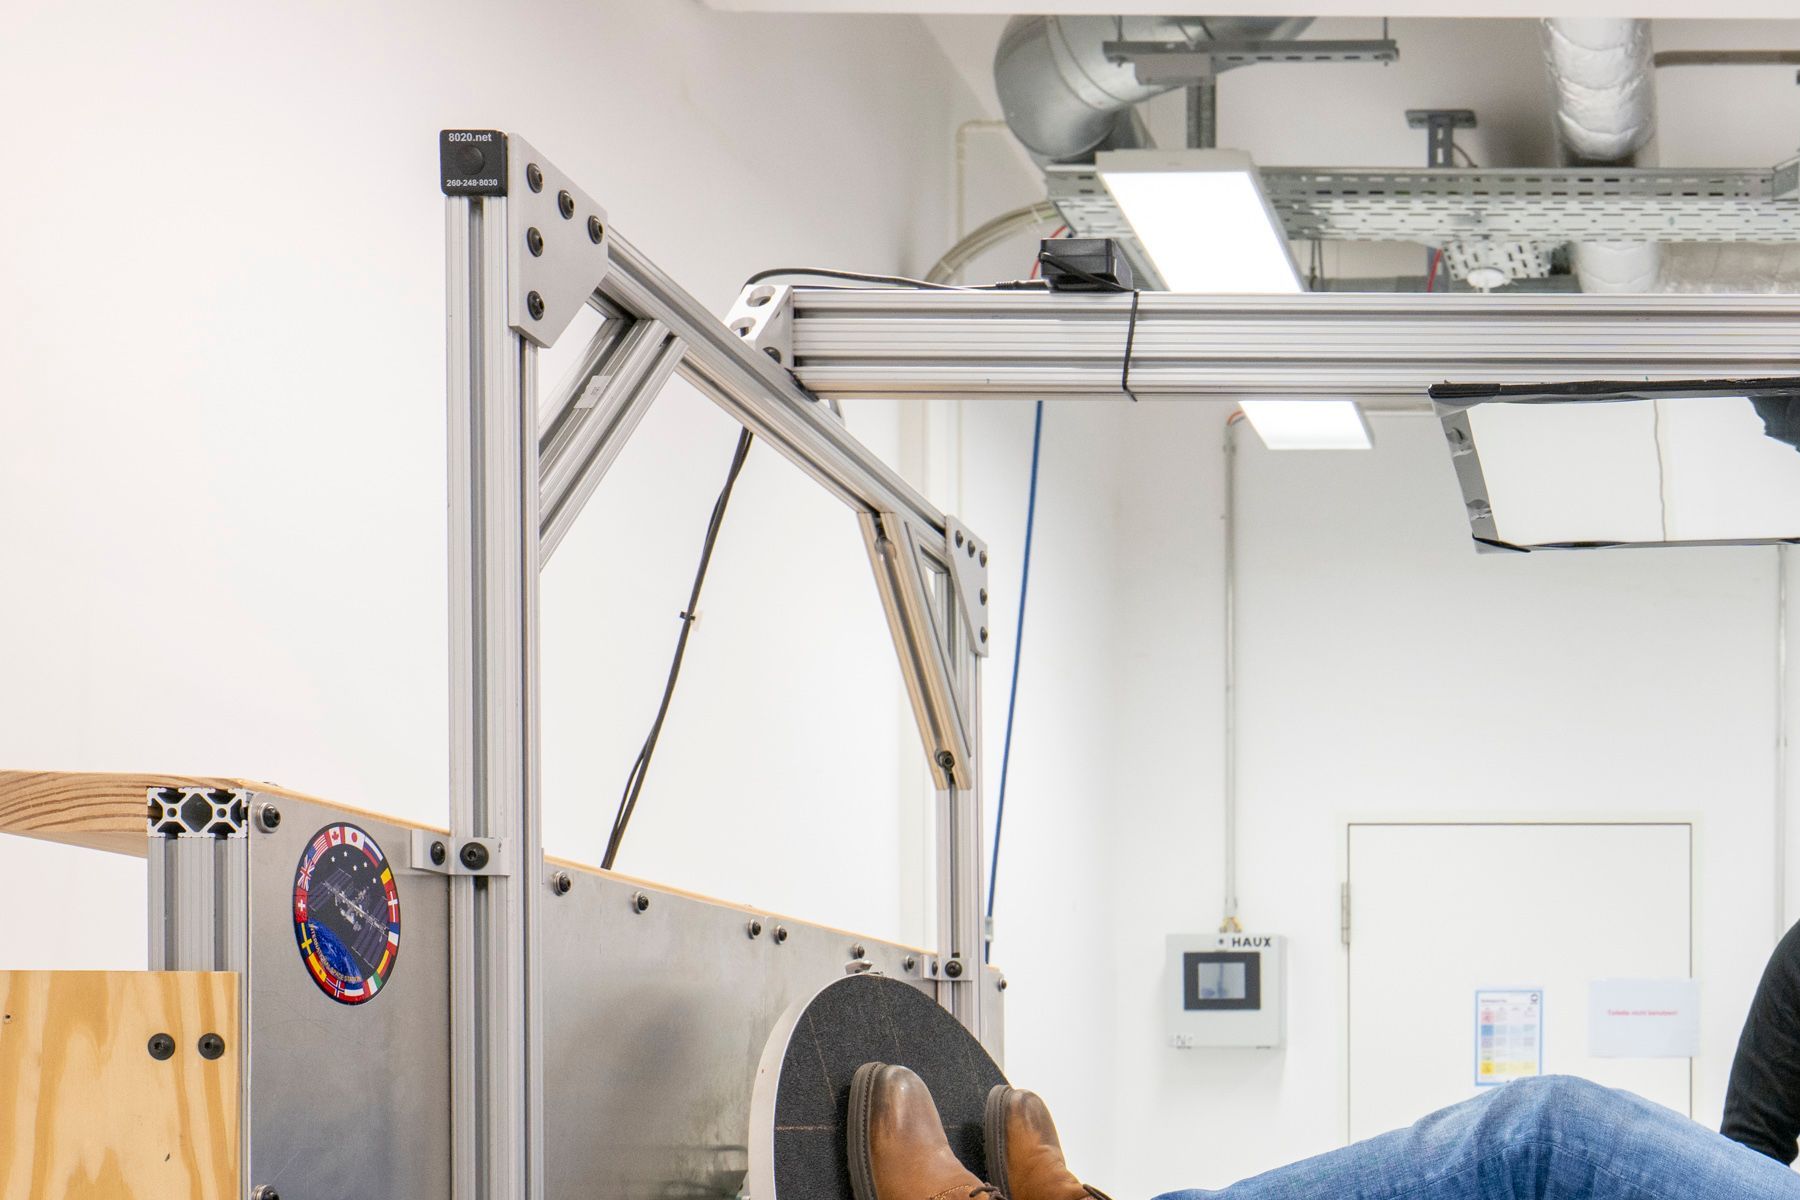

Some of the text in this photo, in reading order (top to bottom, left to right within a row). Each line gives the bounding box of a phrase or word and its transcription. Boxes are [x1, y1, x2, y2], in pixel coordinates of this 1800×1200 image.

[448, 132, 492, 142] 8020.net
[446, 179, 498, 187] 260-248-8030
[1231, 937, 1272, 948] HAUX
